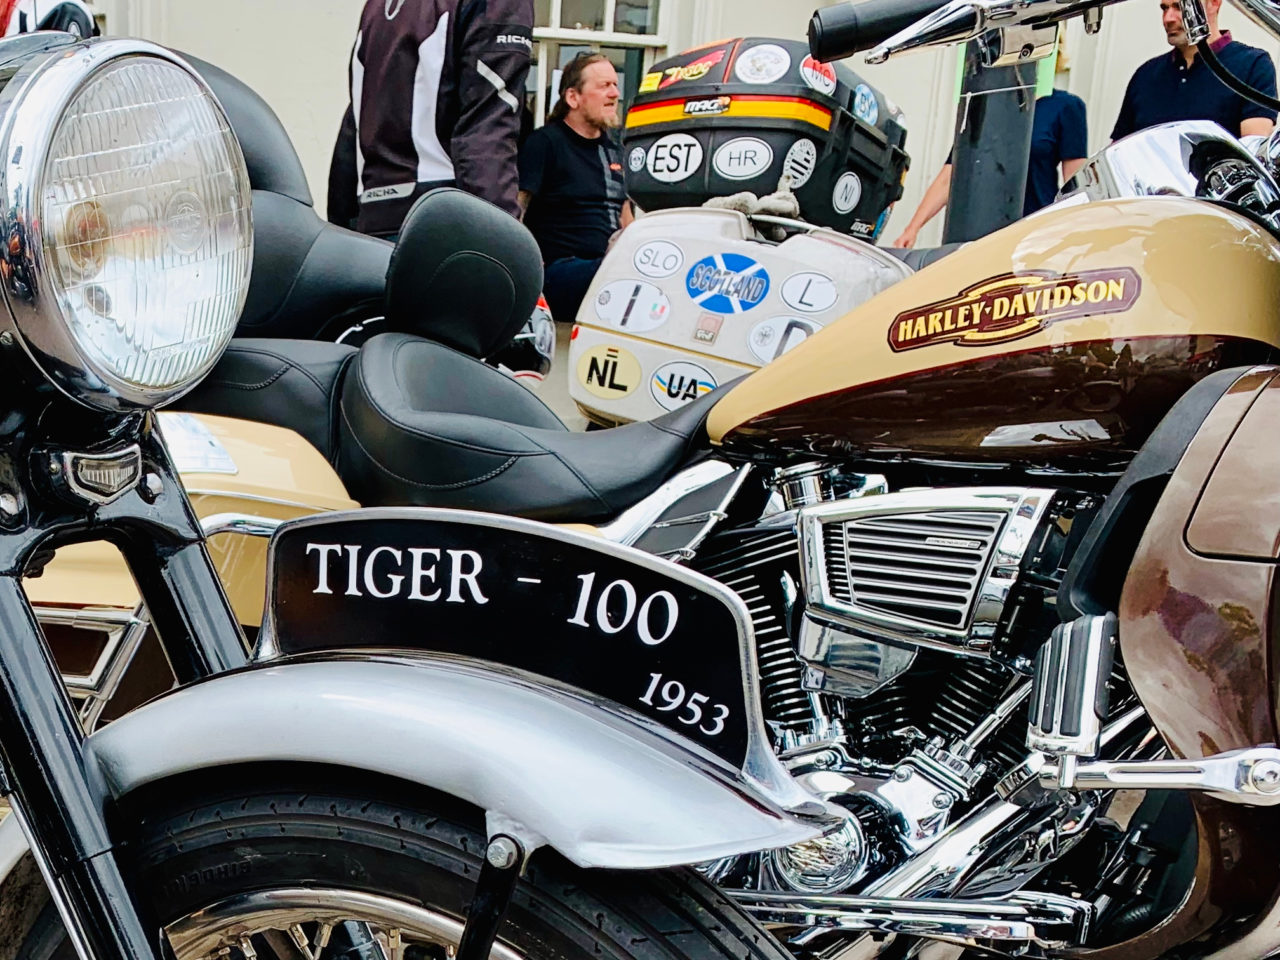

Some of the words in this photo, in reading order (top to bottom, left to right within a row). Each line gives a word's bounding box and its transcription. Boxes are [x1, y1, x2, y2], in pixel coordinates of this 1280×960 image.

[652, 143, 696, 173] EST
[728, 150, 757, 167] HR
[639, 248, 679, 271] SLO
[690, 264, 767, 304] SCOTLAND
[798, 278, 814, 307] L
[586, 356, 628, 392] NL
[666, 373, 698, 401] UA
[306, 543, 489, 604] TIGER
[567, 571, 679, 645] 100
[639, 672, 730, 737] 1953
